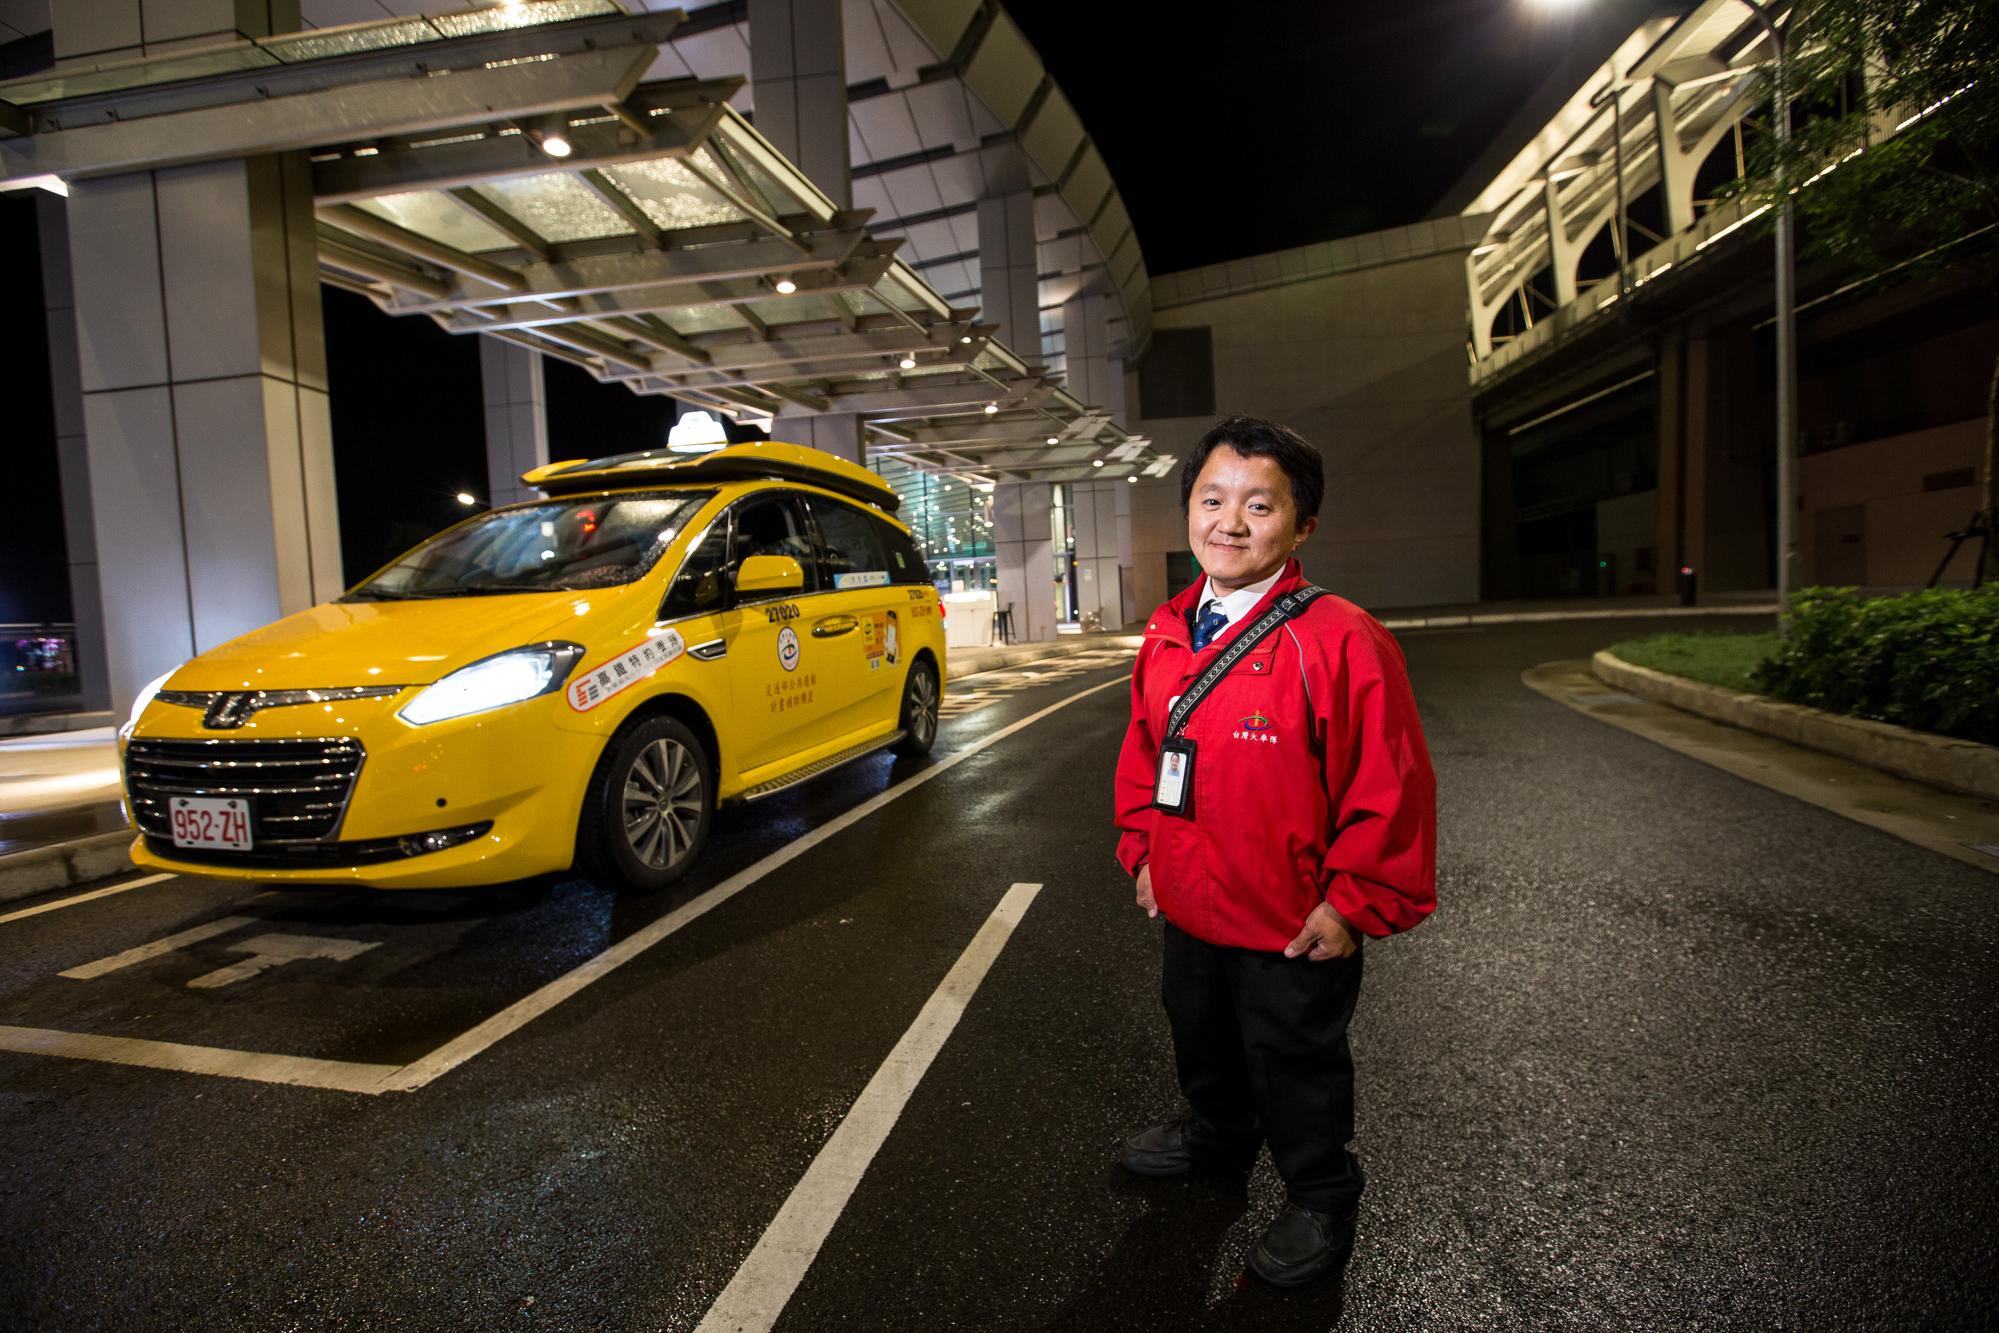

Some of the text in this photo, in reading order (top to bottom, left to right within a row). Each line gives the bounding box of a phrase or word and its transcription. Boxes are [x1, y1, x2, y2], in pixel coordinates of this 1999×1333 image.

[765, 604, 800, 623] 27020
[1232, 730, 1278, 744] 台灣大車隊
[175, 810, 249, 843] 952-ZH
